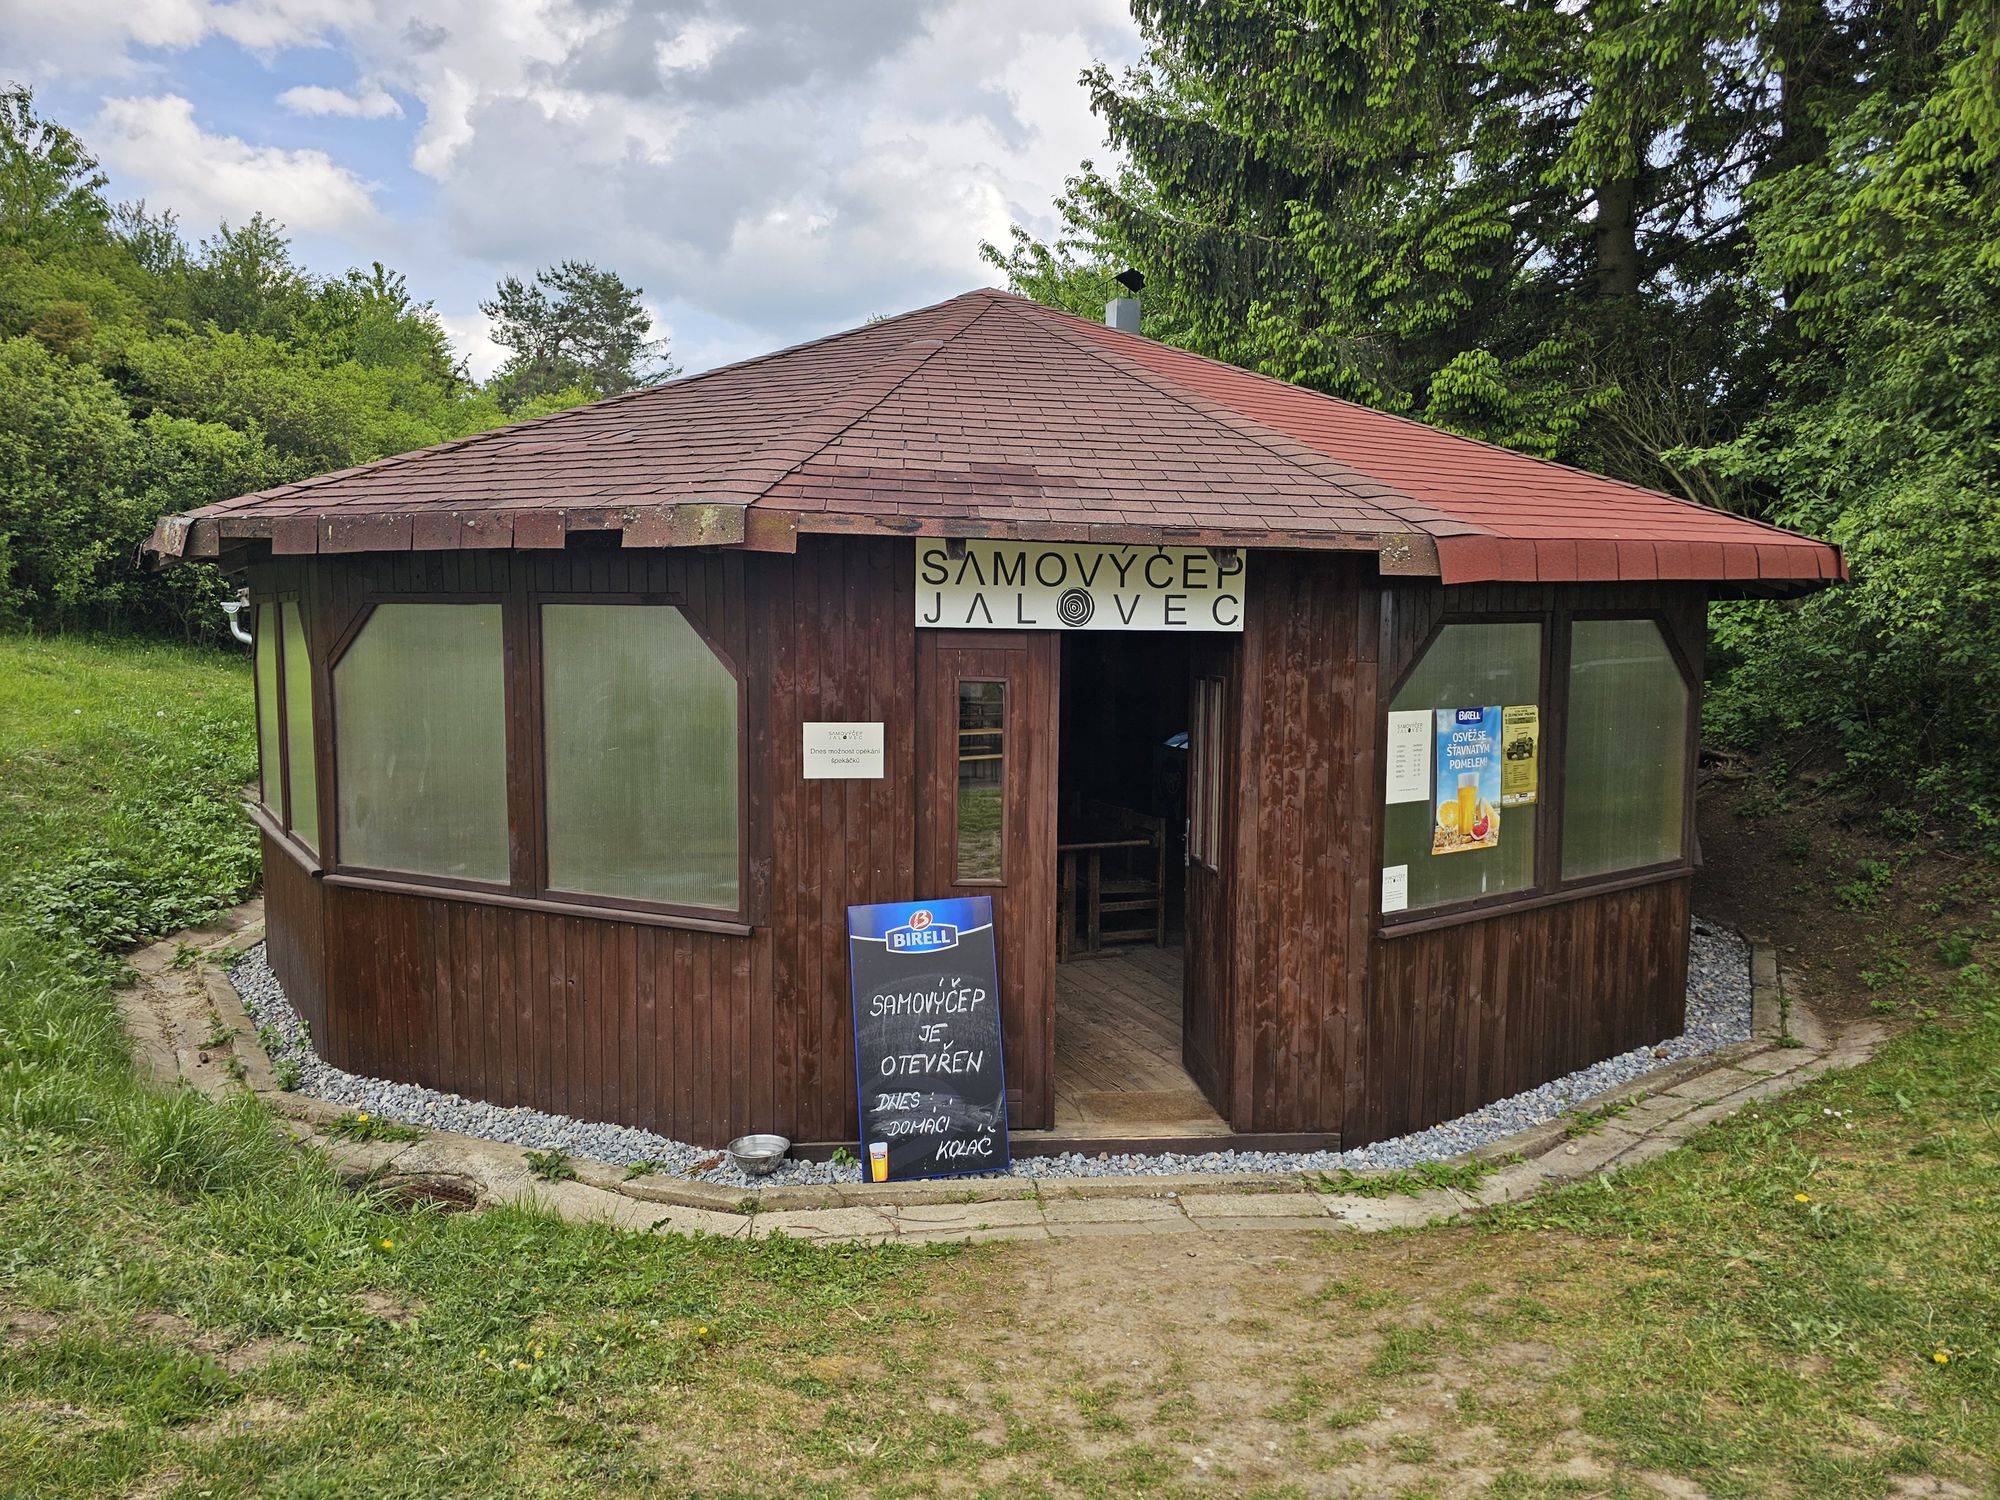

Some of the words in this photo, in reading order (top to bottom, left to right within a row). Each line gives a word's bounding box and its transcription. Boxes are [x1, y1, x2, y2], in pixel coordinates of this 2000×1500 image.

[921, 545, 1243, 589] SAMOVÝČEP
[1458, 710, 1481, 721] BIRELL
[1452, 728, 1477, 743] OSVĚŽ
[1477, 730, 1487, 741] SE
[1446, 741, 1490, 757] ŠŤAVNATÝM
[1449, 757, 1488, 770] POMELEM!
[893, 930, 950, 947] BIRELL
[870, 977, 985, 1016] SAMOVÝČEP
[918, 1023, 948, 1042] JE
[881, 1040, 983, 1076] OTEVŘEN
[935, 1122, 996, 1161] KOLÁČ
